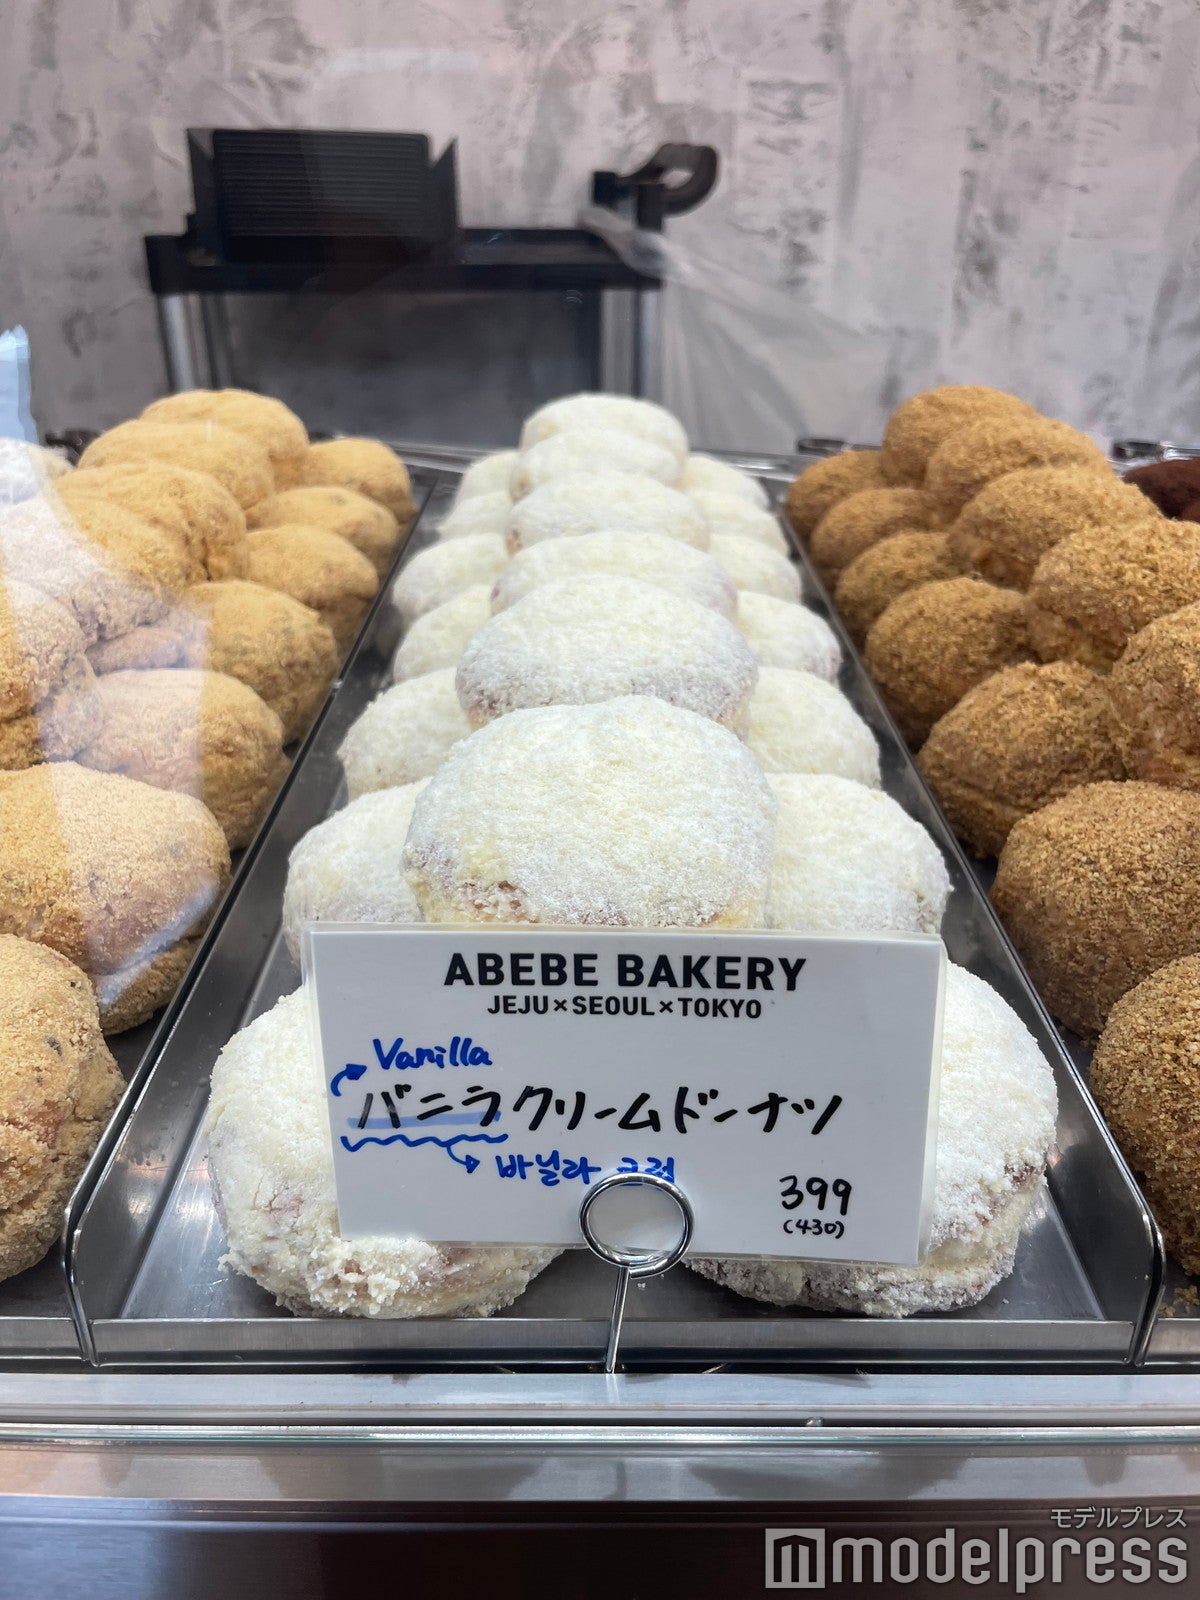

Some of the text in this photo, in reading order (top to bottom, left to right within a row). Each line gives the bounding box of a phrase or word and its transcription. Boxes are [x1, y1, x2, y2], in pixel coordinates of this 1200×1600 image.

[443, 952, 807, 991] ABEBE BAKERY
[373, 1036, 493, 1070] Vanilla
[357, 1084, 843, 1137] バニラクリームドーナツ
[495, 1149, 602, 1187] 바닐라
[779, 1175, 853, 1216] 399
[782, 1219, 846, 1240] (430)
